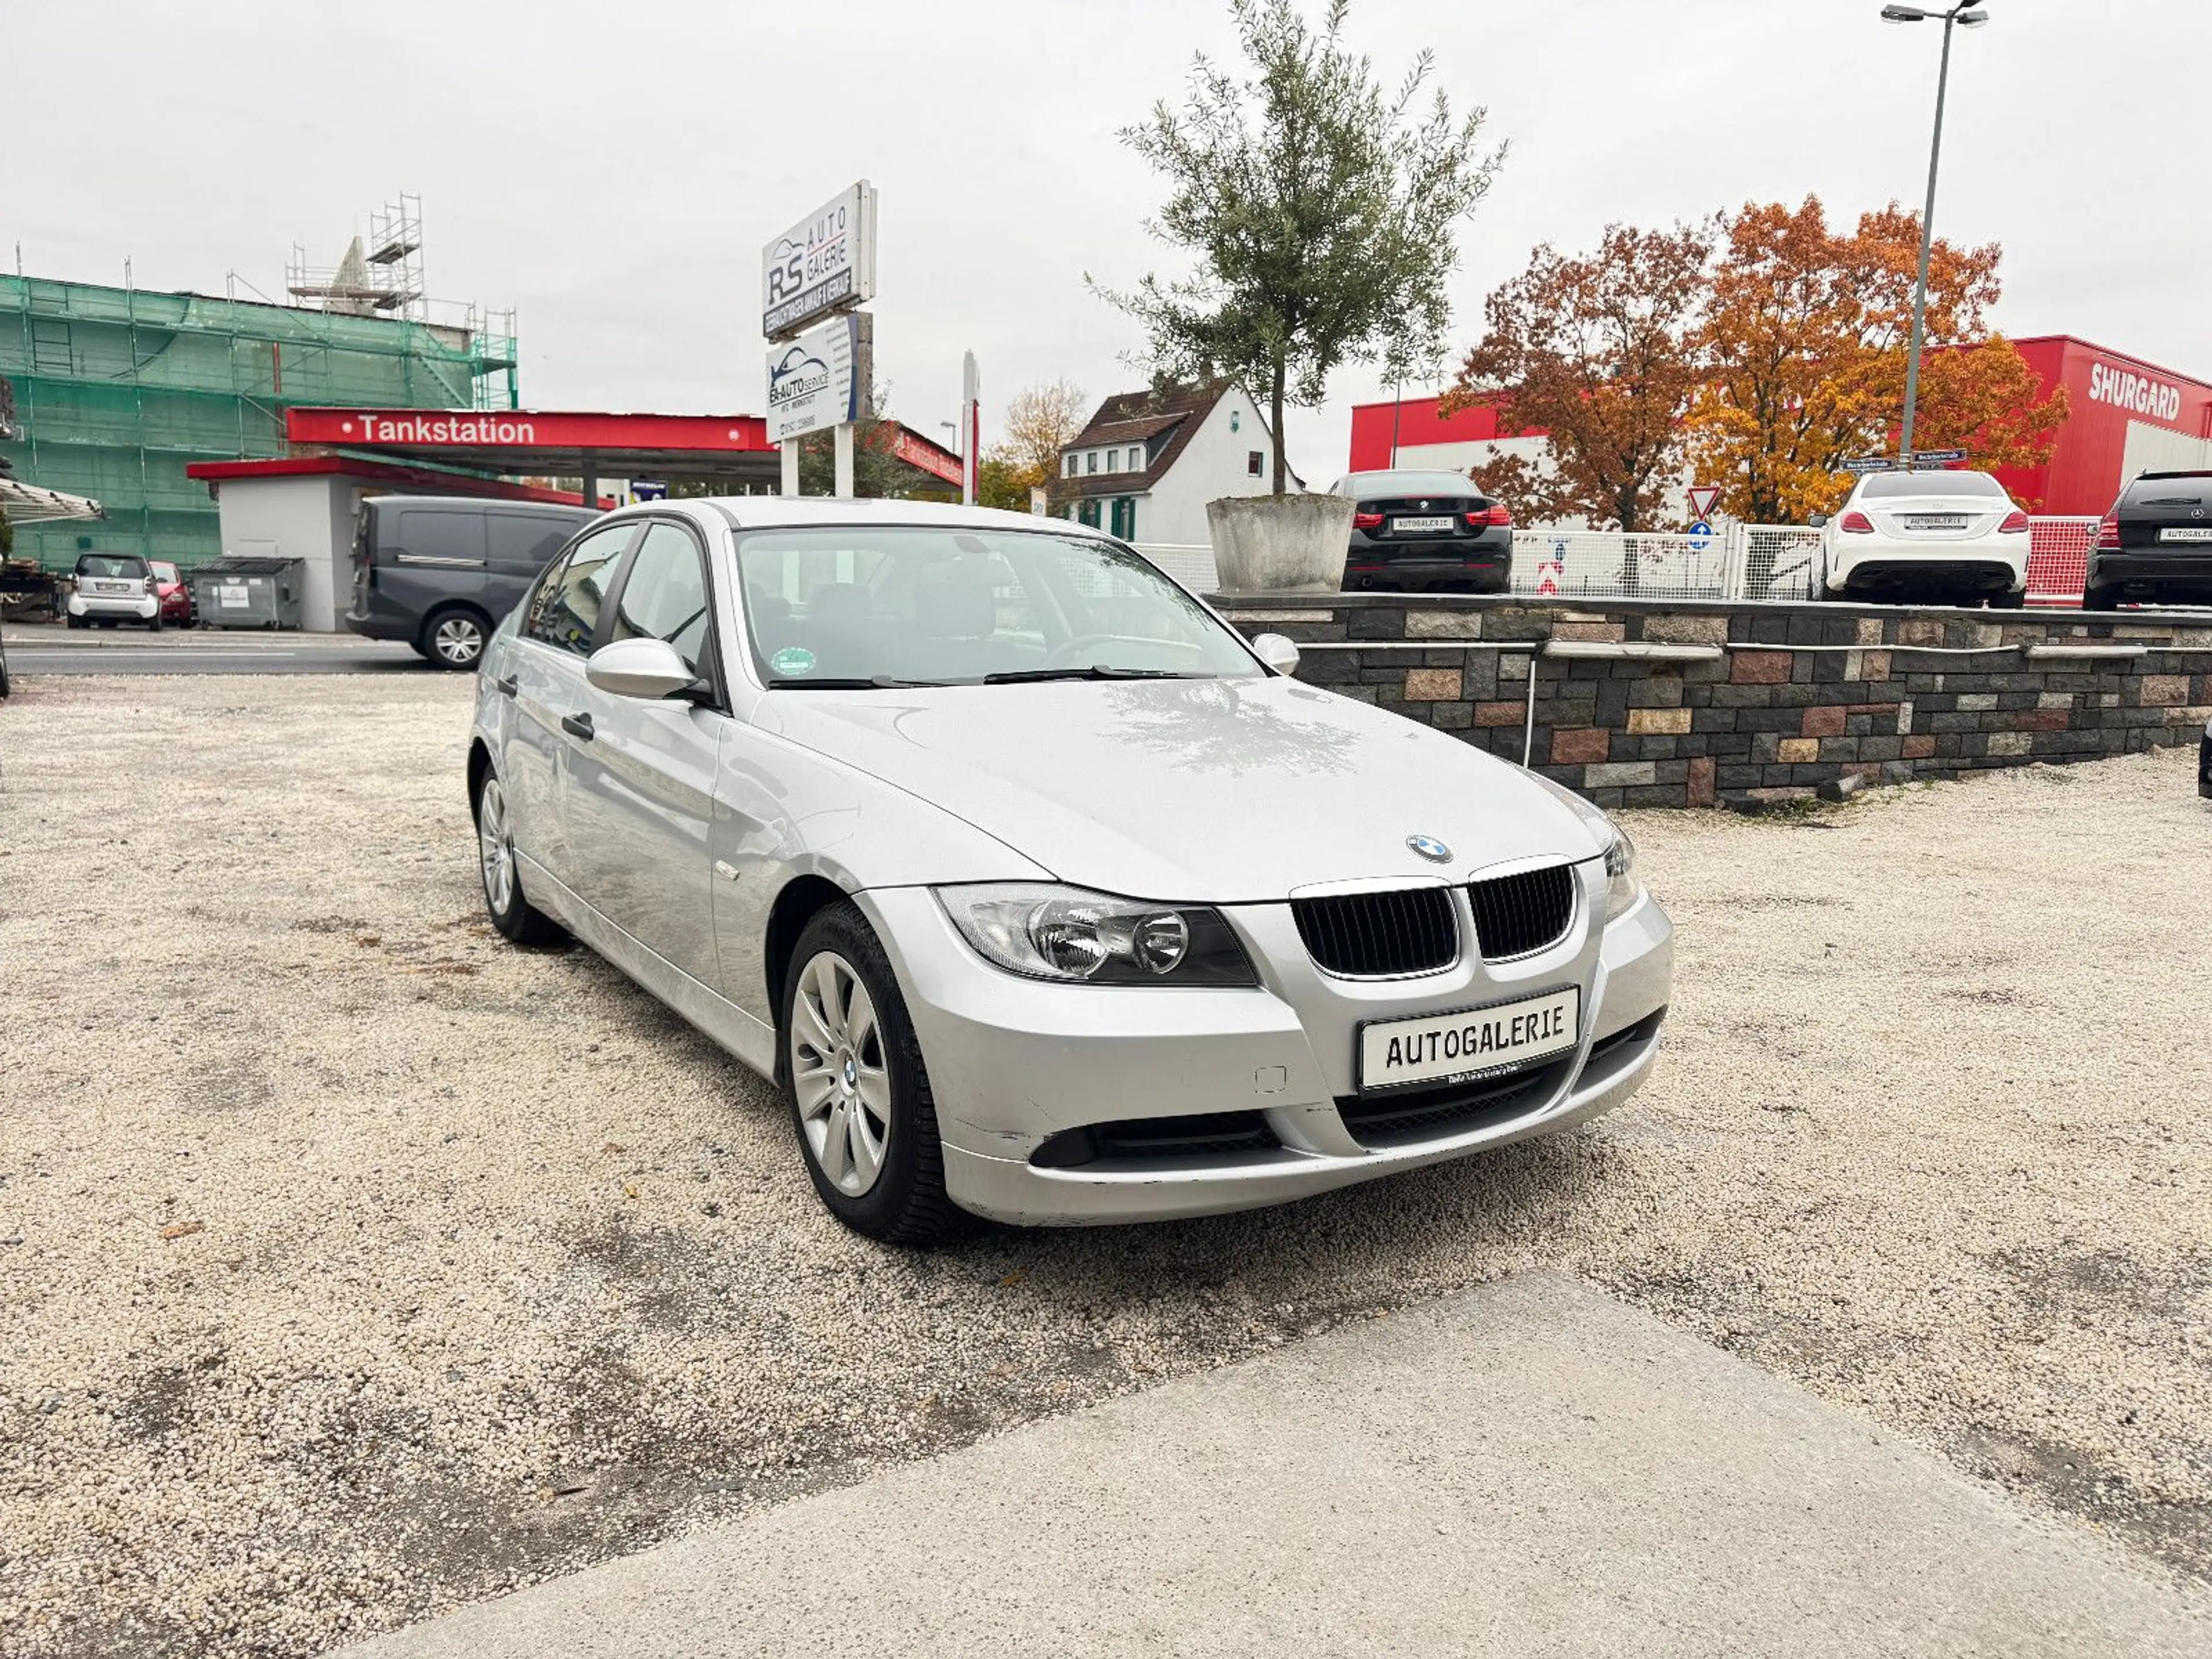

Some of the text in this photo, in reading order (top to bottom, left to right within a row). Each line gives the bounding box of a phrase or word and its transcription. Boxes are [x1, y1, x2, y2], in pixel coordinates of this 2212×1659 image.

[808, 206, 845, 251] AUTO
[769, 253, 802, 305] RS
[808, 238, 845, 281] GALERIE
[2089, 362, 2180, 421] SHURGARD
[358, 415, 535, 443] Tankstation
[1397, 520, 1448, 528] AUTOGALERIE
[1387, 1005, 1563, 1067] AUTOGALERIE
